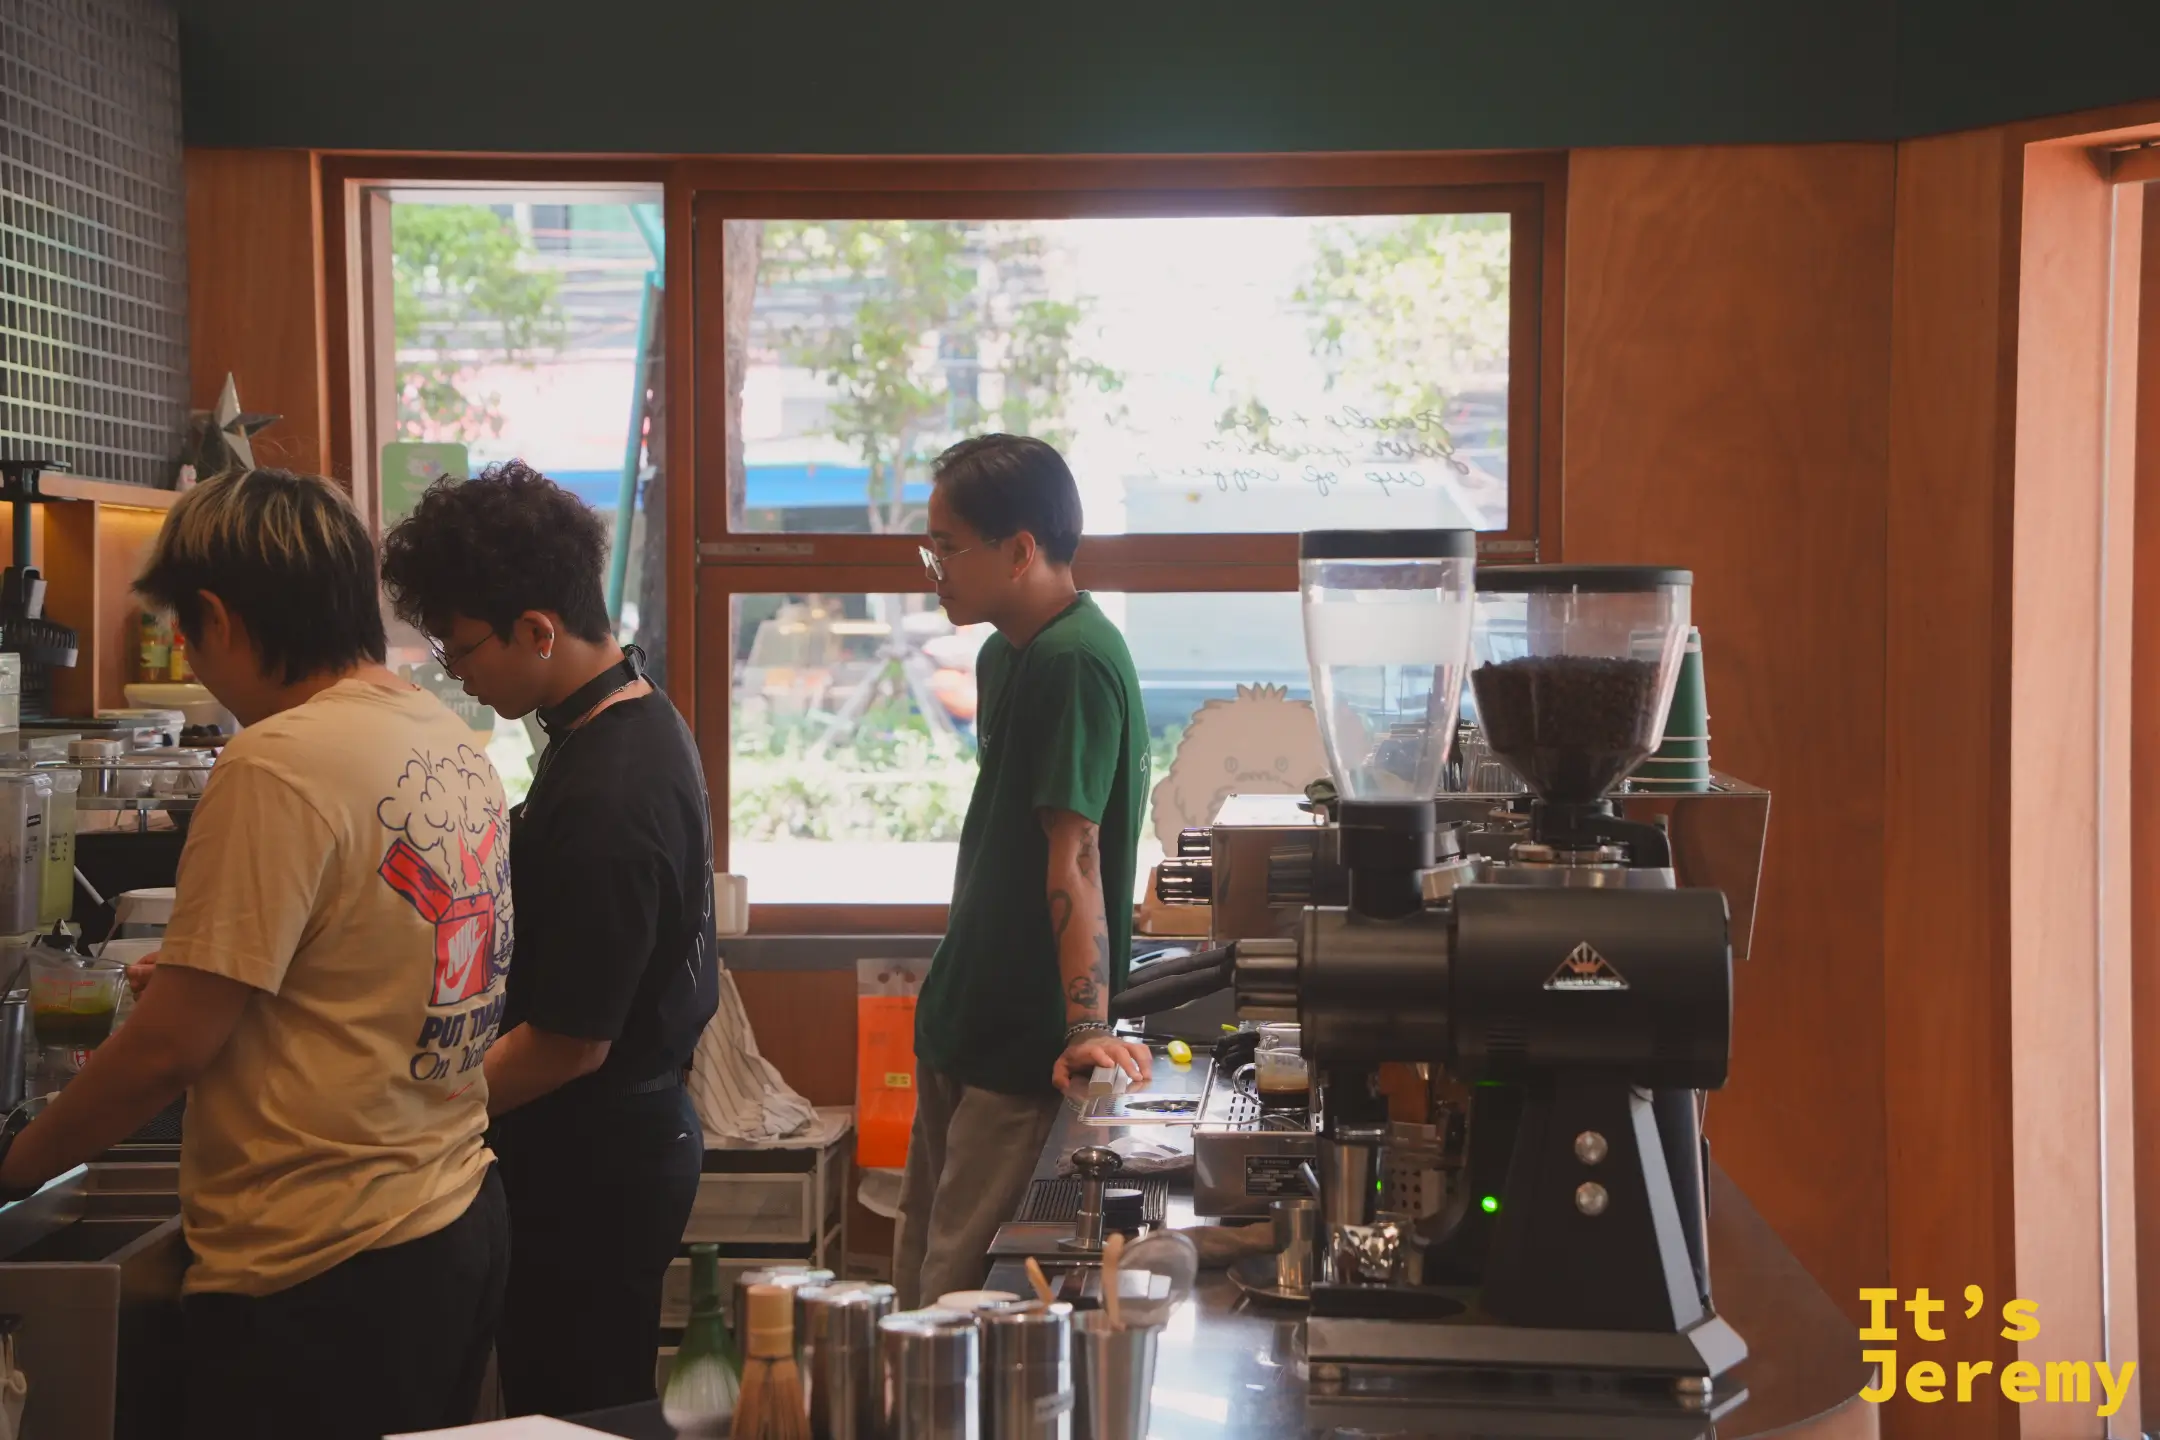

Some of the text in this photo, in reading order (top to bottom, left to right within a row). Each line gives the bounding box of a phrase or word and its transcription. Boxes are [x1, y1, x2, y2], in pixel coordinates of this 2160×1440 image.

[446, 915, 481, 980] NIKE
[416, 1012, 467, 1049] PUT
[410, 1051, 451, 1081] On
